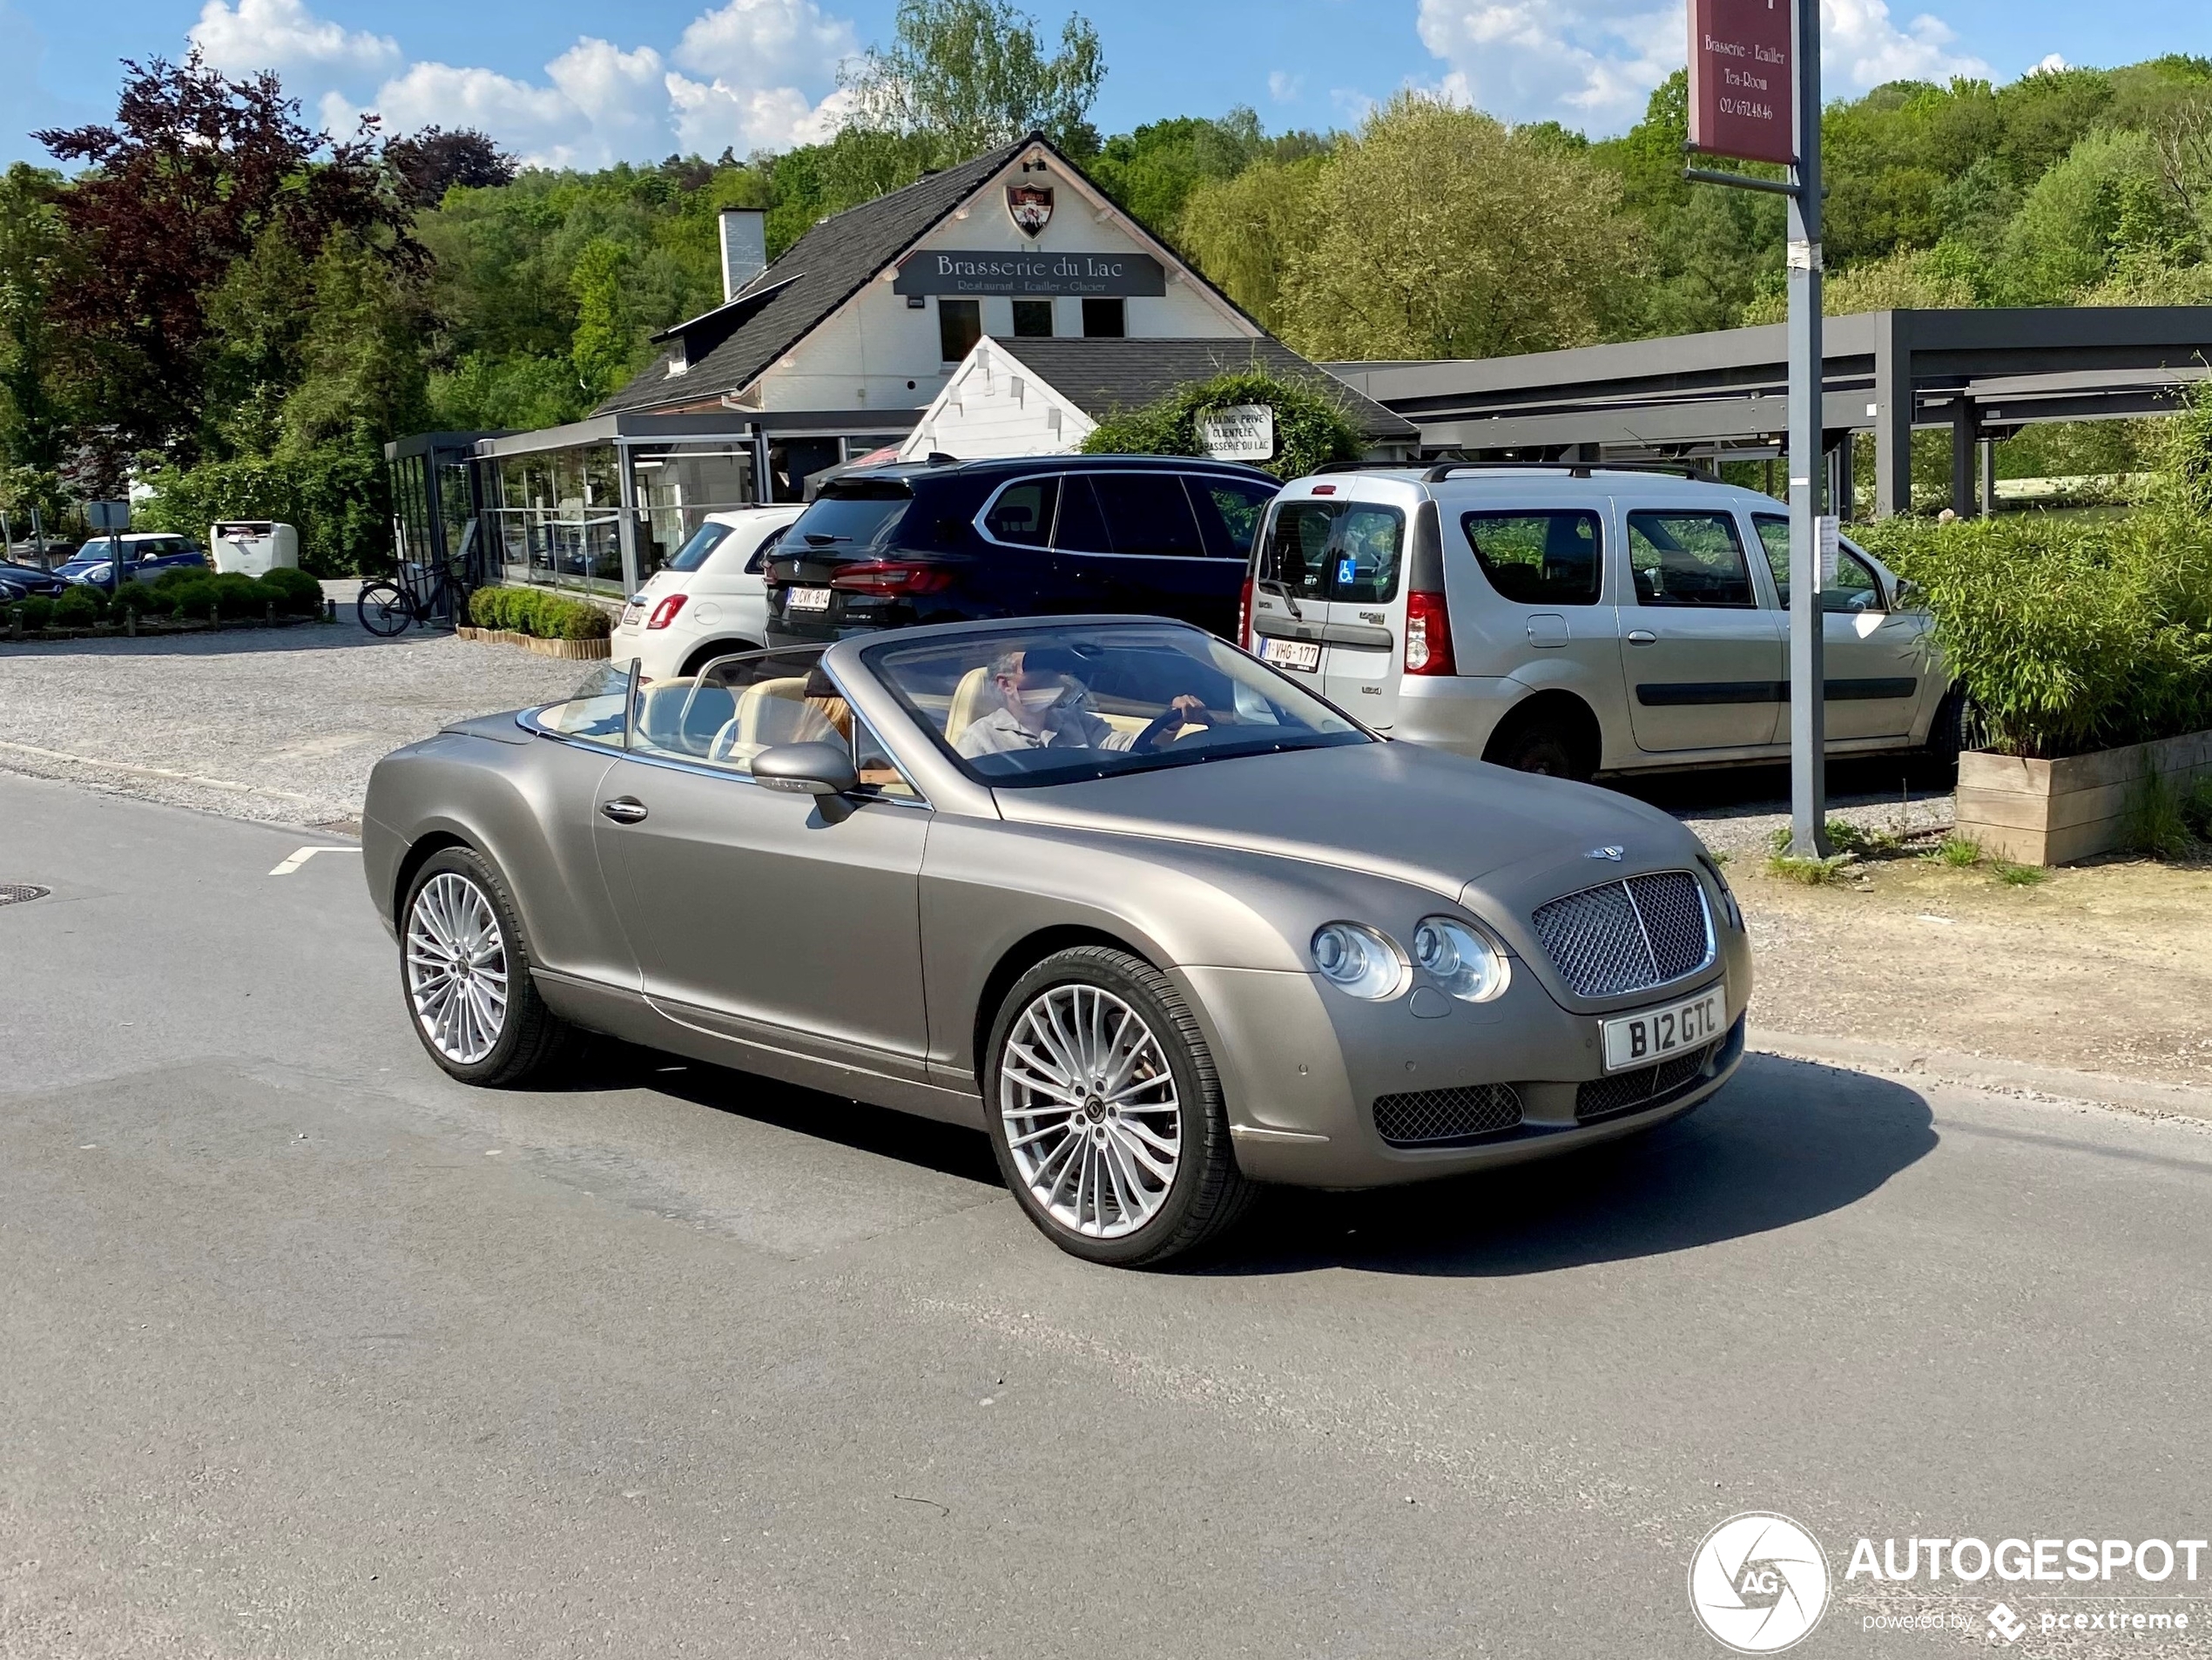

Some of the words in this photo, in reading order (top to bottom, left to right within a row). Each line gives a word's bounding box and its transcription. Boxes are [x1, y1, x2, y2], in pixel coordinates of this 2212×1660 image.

[1705, 34, 1745, 57] Brasserie
[1724, 68, 1768, 91] Tea-Room
[937, 255, 1046, 276] Brasserie
[1053, 257, 1079, 276] du
[1087, 258, 1123, 277] Lac
[958, 280, 1015, 291] Restaurant
[1069, 280, 1106, 292] Glacier
[1254, 441, 1269, 450] LAC
[1681, 998, 1716, 1042] GTC
